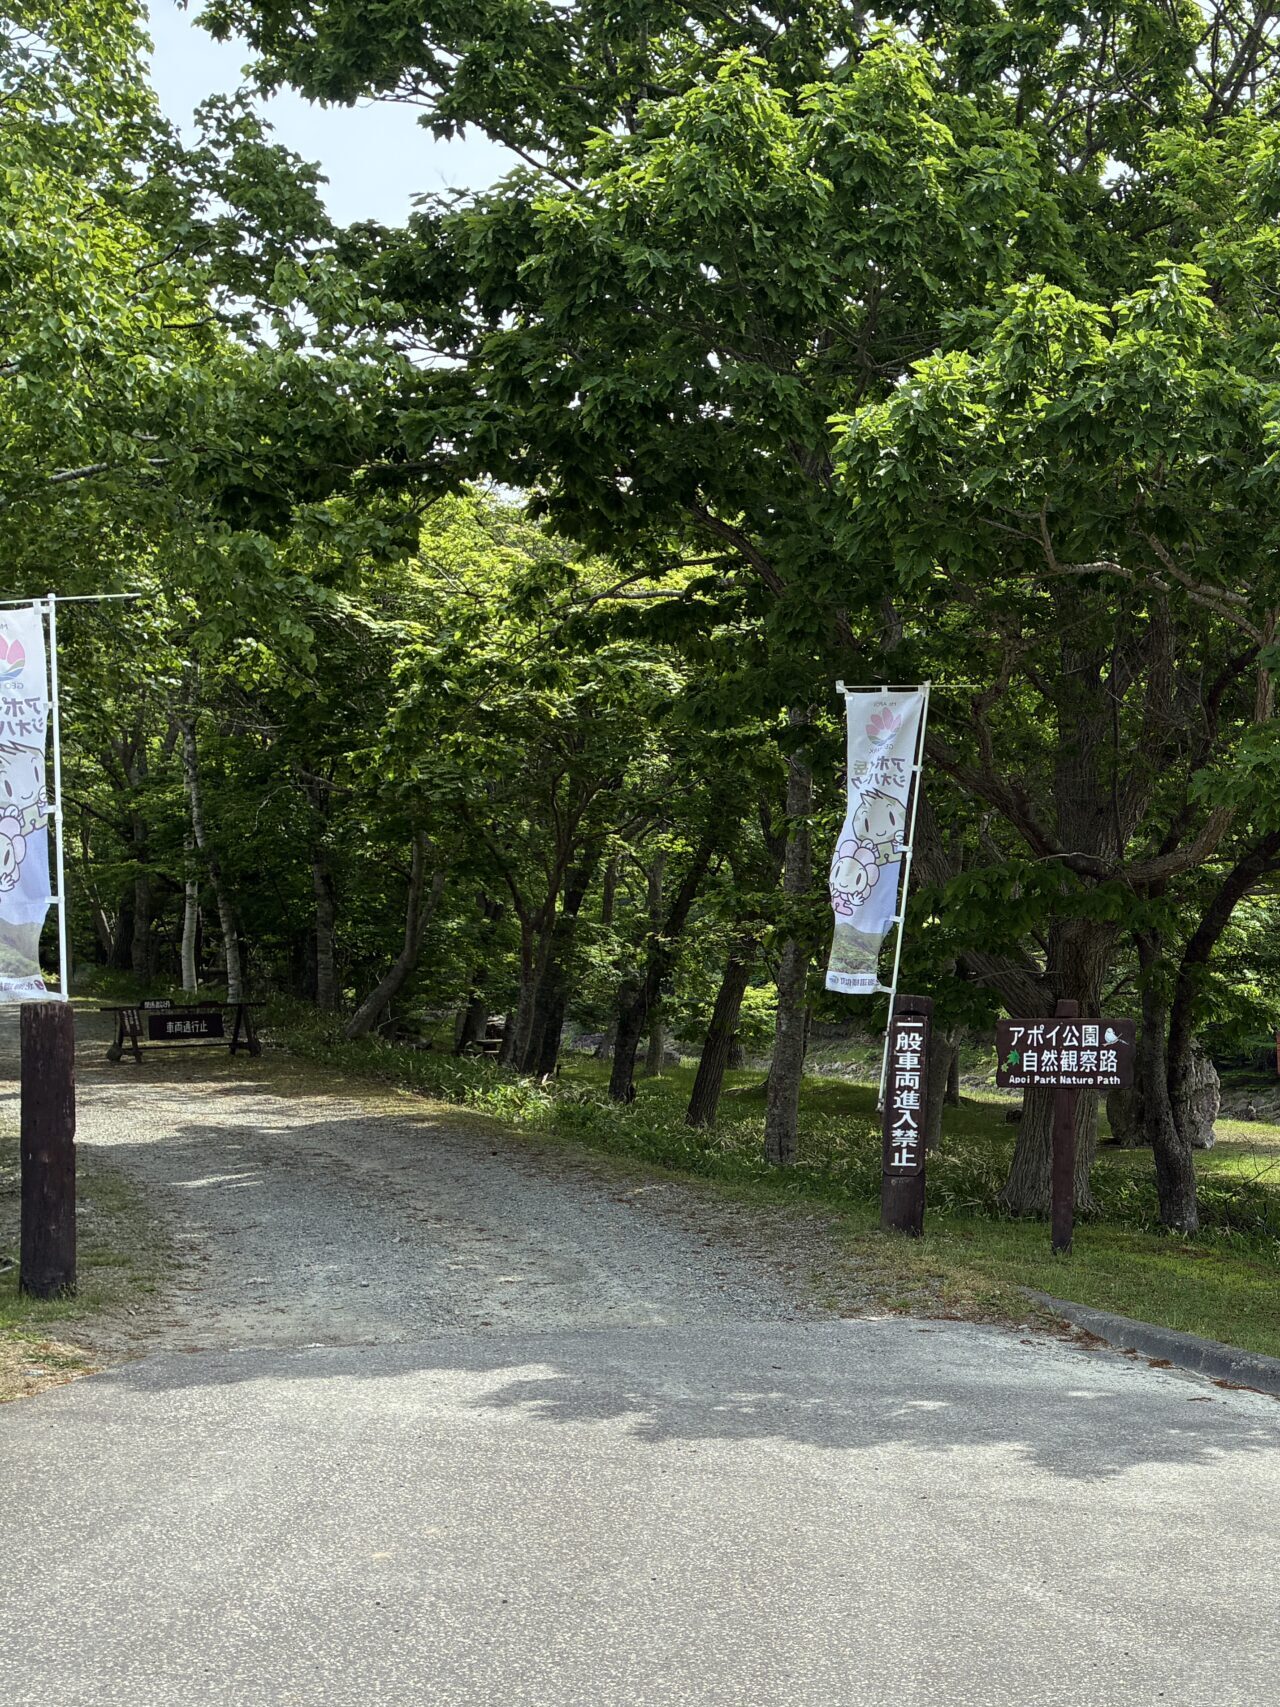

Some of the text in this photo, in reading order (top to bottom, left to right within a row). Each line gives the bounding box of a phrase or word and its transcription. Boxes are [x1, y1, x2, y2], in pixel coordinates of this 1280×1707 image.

[166, 1020, 208, 1033] 車両通行止
[1009, 1024, 1099, 1047] アポイ公園
[1022, 1049, 1118, 1073] 自然観察路
[1009, 1074, 1121, 1085] Apoi Park Nature Path
[890, 1021, 924, 1168] 一般車両進入禁止
